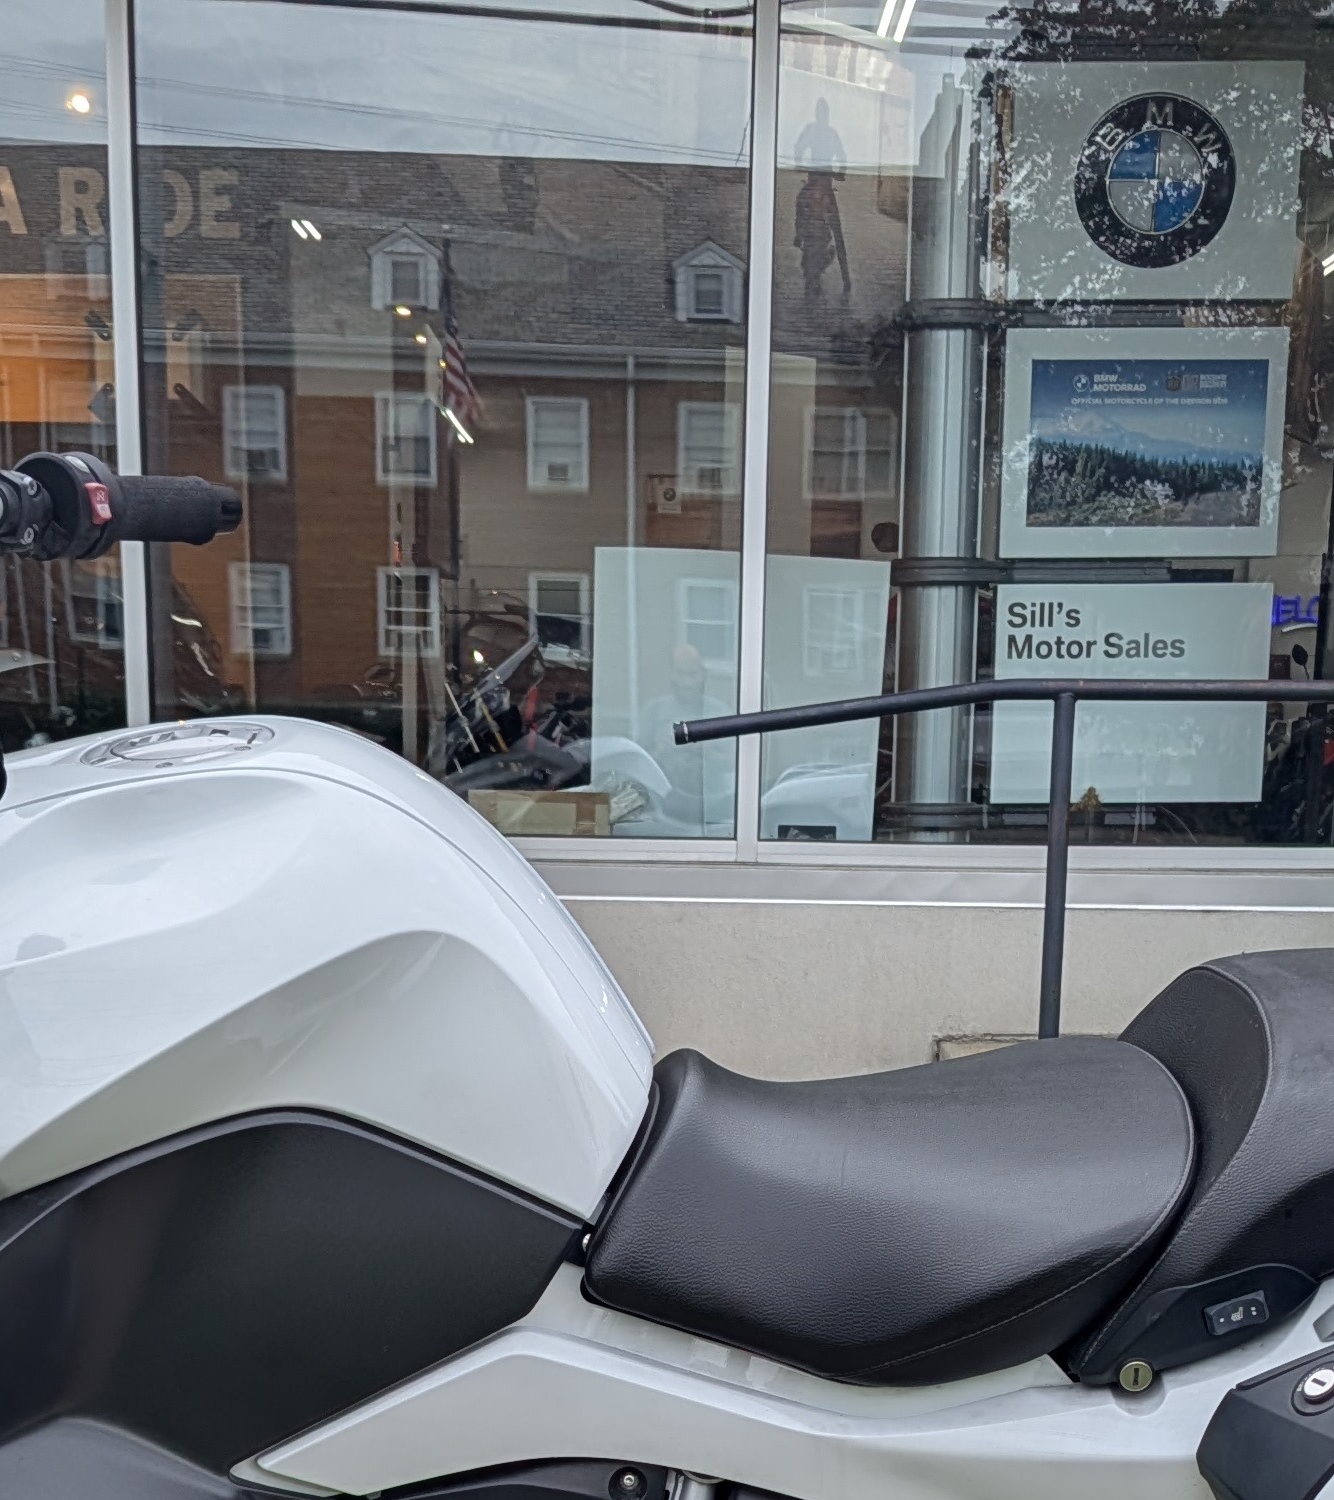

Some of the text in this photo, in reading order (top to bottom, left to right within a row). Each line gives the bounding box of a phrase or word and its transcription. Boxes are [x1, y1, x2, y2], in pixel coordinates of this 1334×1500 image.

[1090, 101, 1222, 153] BMW
[58, 166, 242, 240] RDE
[1093, 383, 1147, 392] MOTORRAD
[1007, 602, 1081, 628] Sill's
[1006, 632, 1186, 660] Motor Sales
